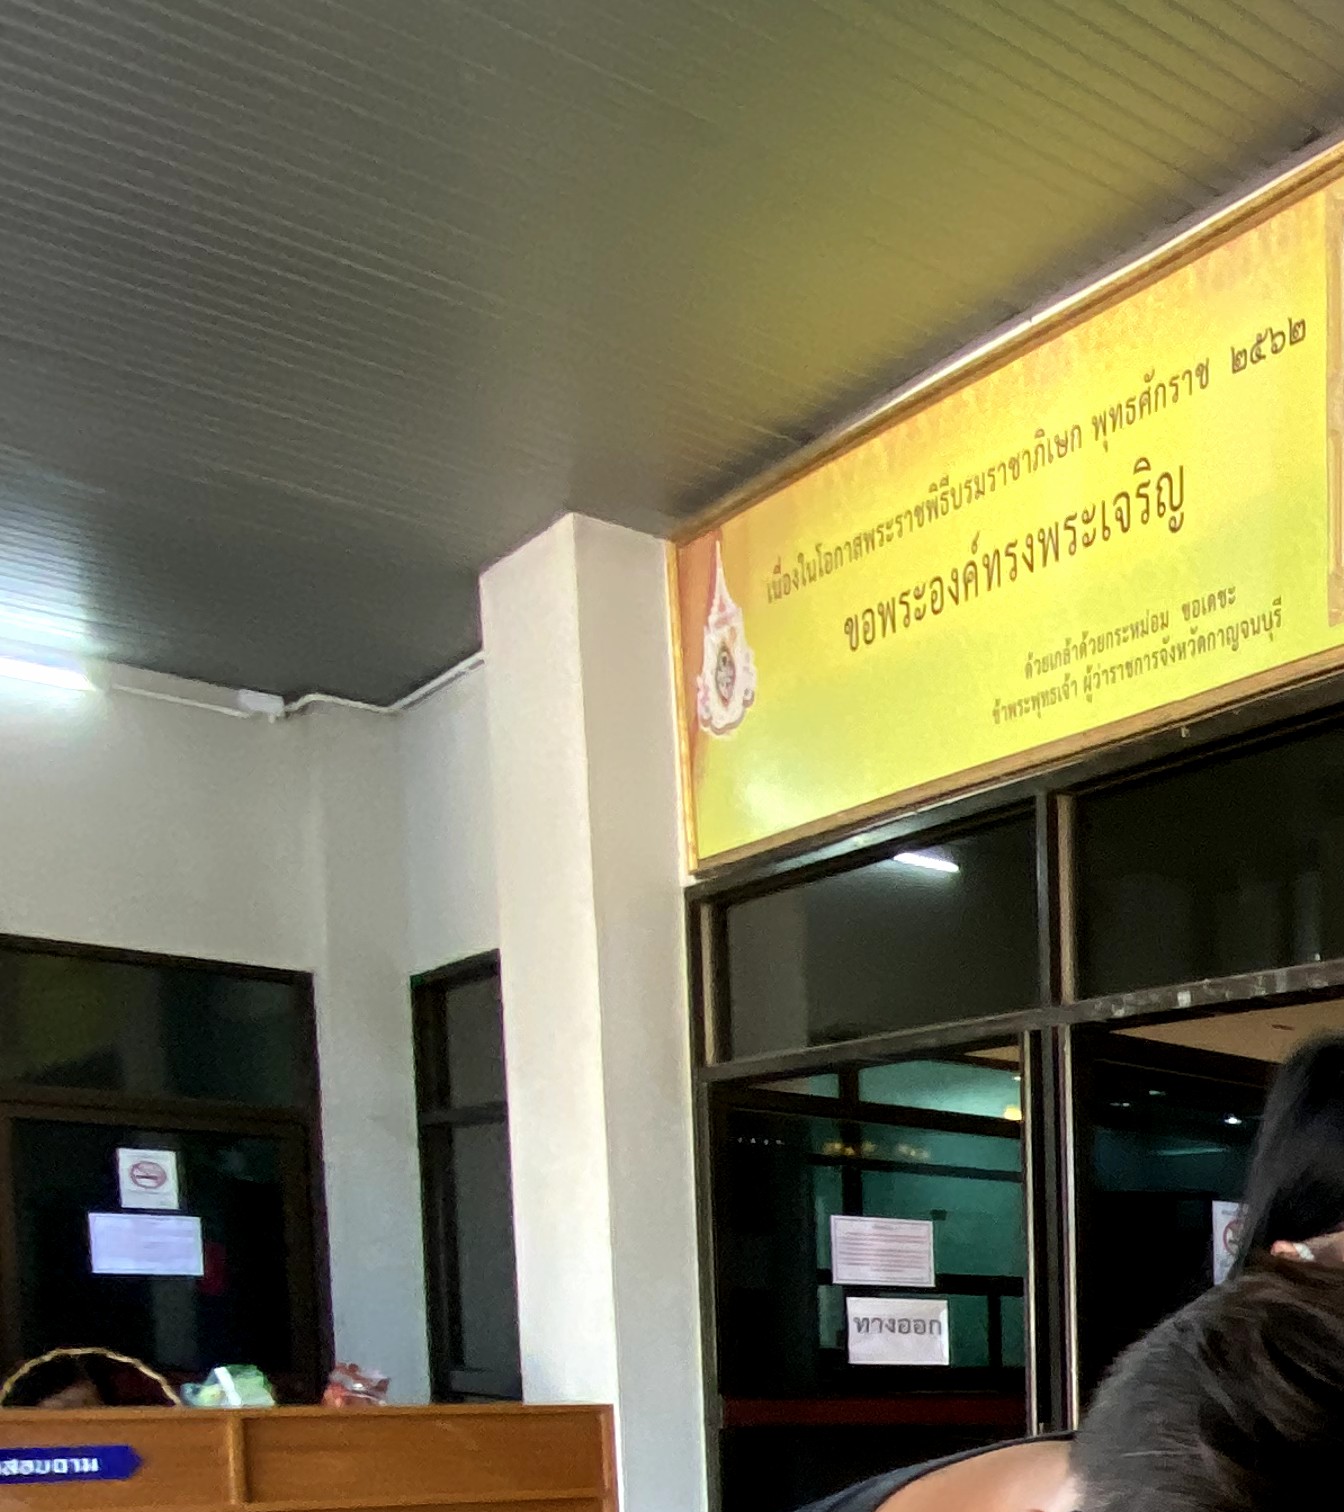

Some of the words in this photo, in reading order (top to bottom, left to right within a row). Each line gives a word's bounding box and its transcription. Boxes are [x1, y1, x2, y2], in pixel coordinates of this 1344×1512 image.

[766, 424, 1083, 605] เนื่องในโอกาสพระราชพิธีบรมราชาภิเษก
[1091, 357, 1210, 452] พุทธศักราช
[1230, 317, 1306, 374] ๒๕๖๒
[844, 456, 1185, 652] ขอพระองค์ทรงพระเจริญ
[853, 1316, 942, 1336] ทางออก
